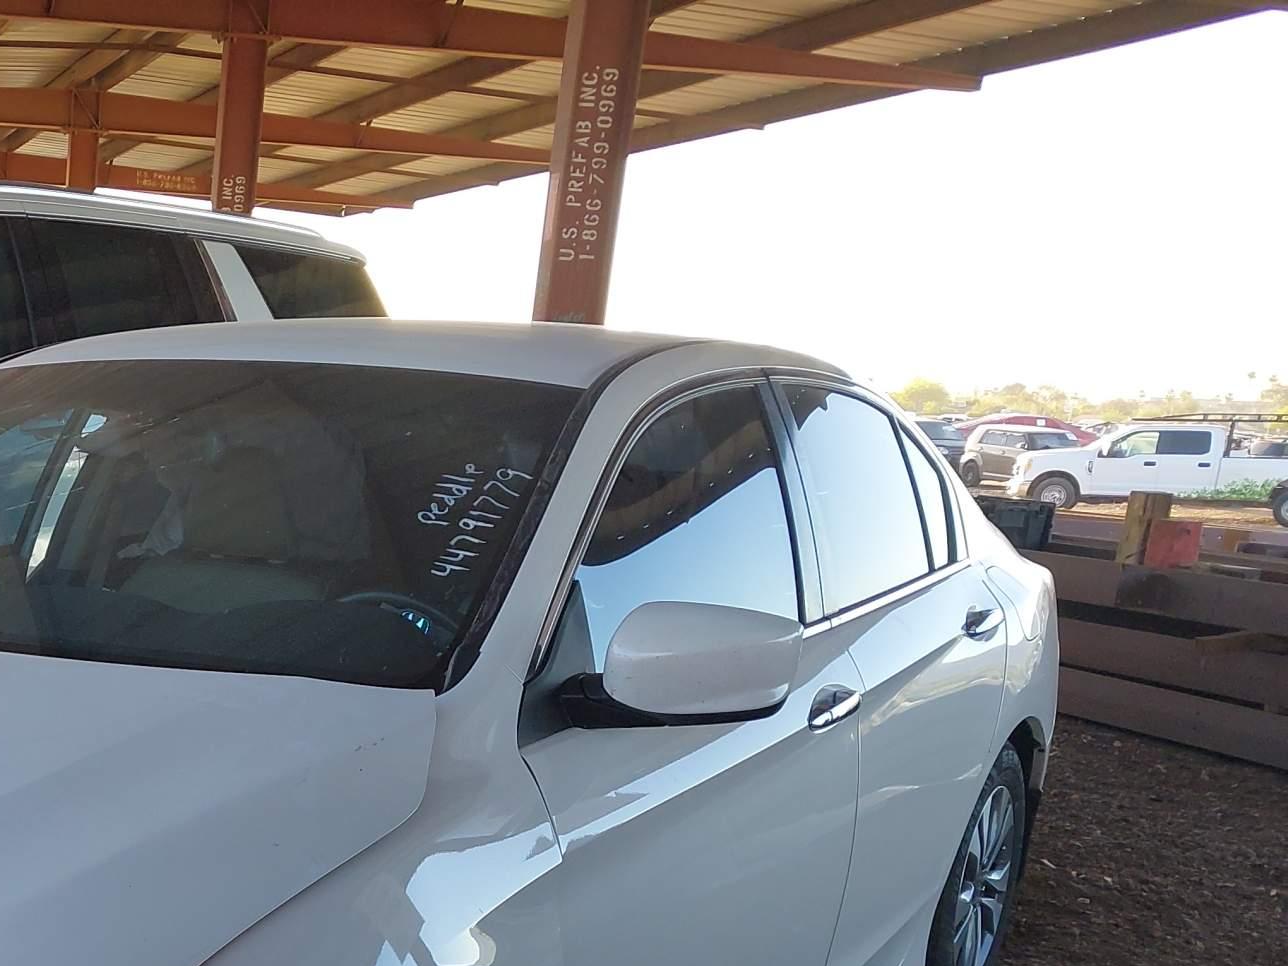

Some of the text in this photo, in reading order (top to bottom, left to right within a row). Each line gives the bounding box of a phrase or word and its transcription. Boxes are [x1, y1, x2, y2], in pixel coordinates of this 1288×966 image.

[558, 65, 601, 261] U.S. PREFAB INC.
[579, 67, 620, 260] 1-866-799-0969
[430, 467, 534, 577] 44791779
